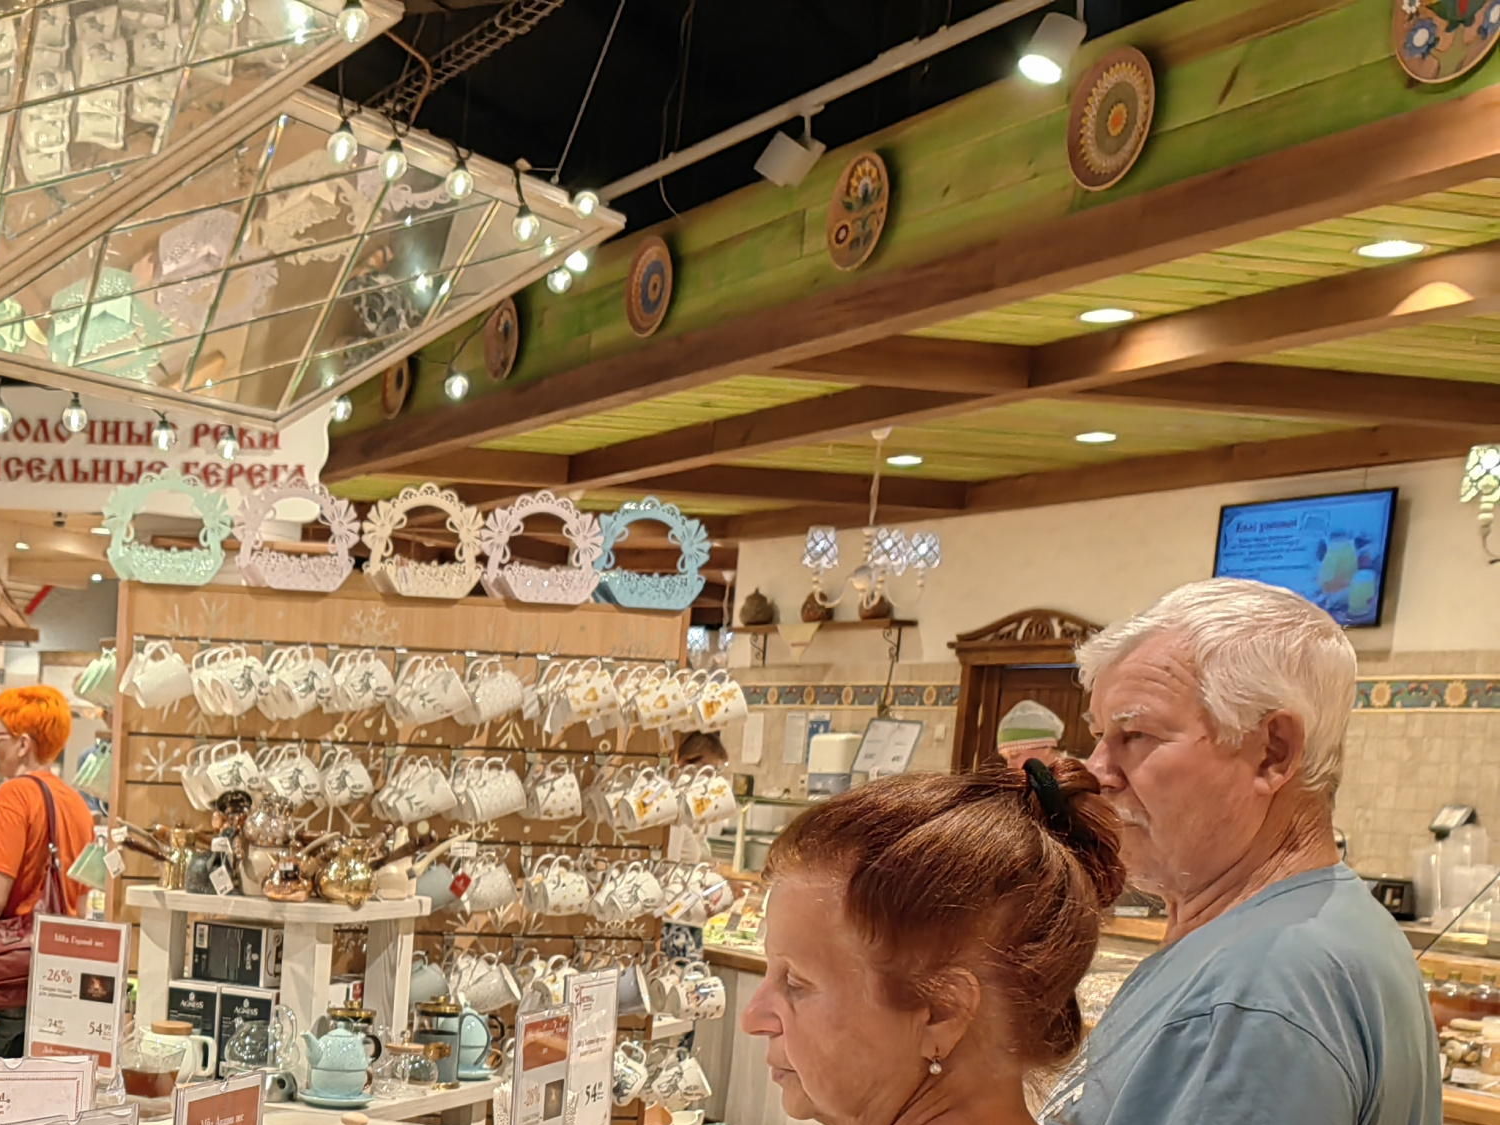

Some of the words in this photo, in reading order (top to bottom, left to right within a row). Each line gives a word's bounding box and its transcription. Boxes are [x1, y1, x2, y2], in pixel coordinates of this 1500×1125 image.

[43, 968, 72, 984] -26%
[88, 1021, 102, 1036] 54
[585, 1082, 597, 1106] 54
[235, 1113, 244, 1123] вес
